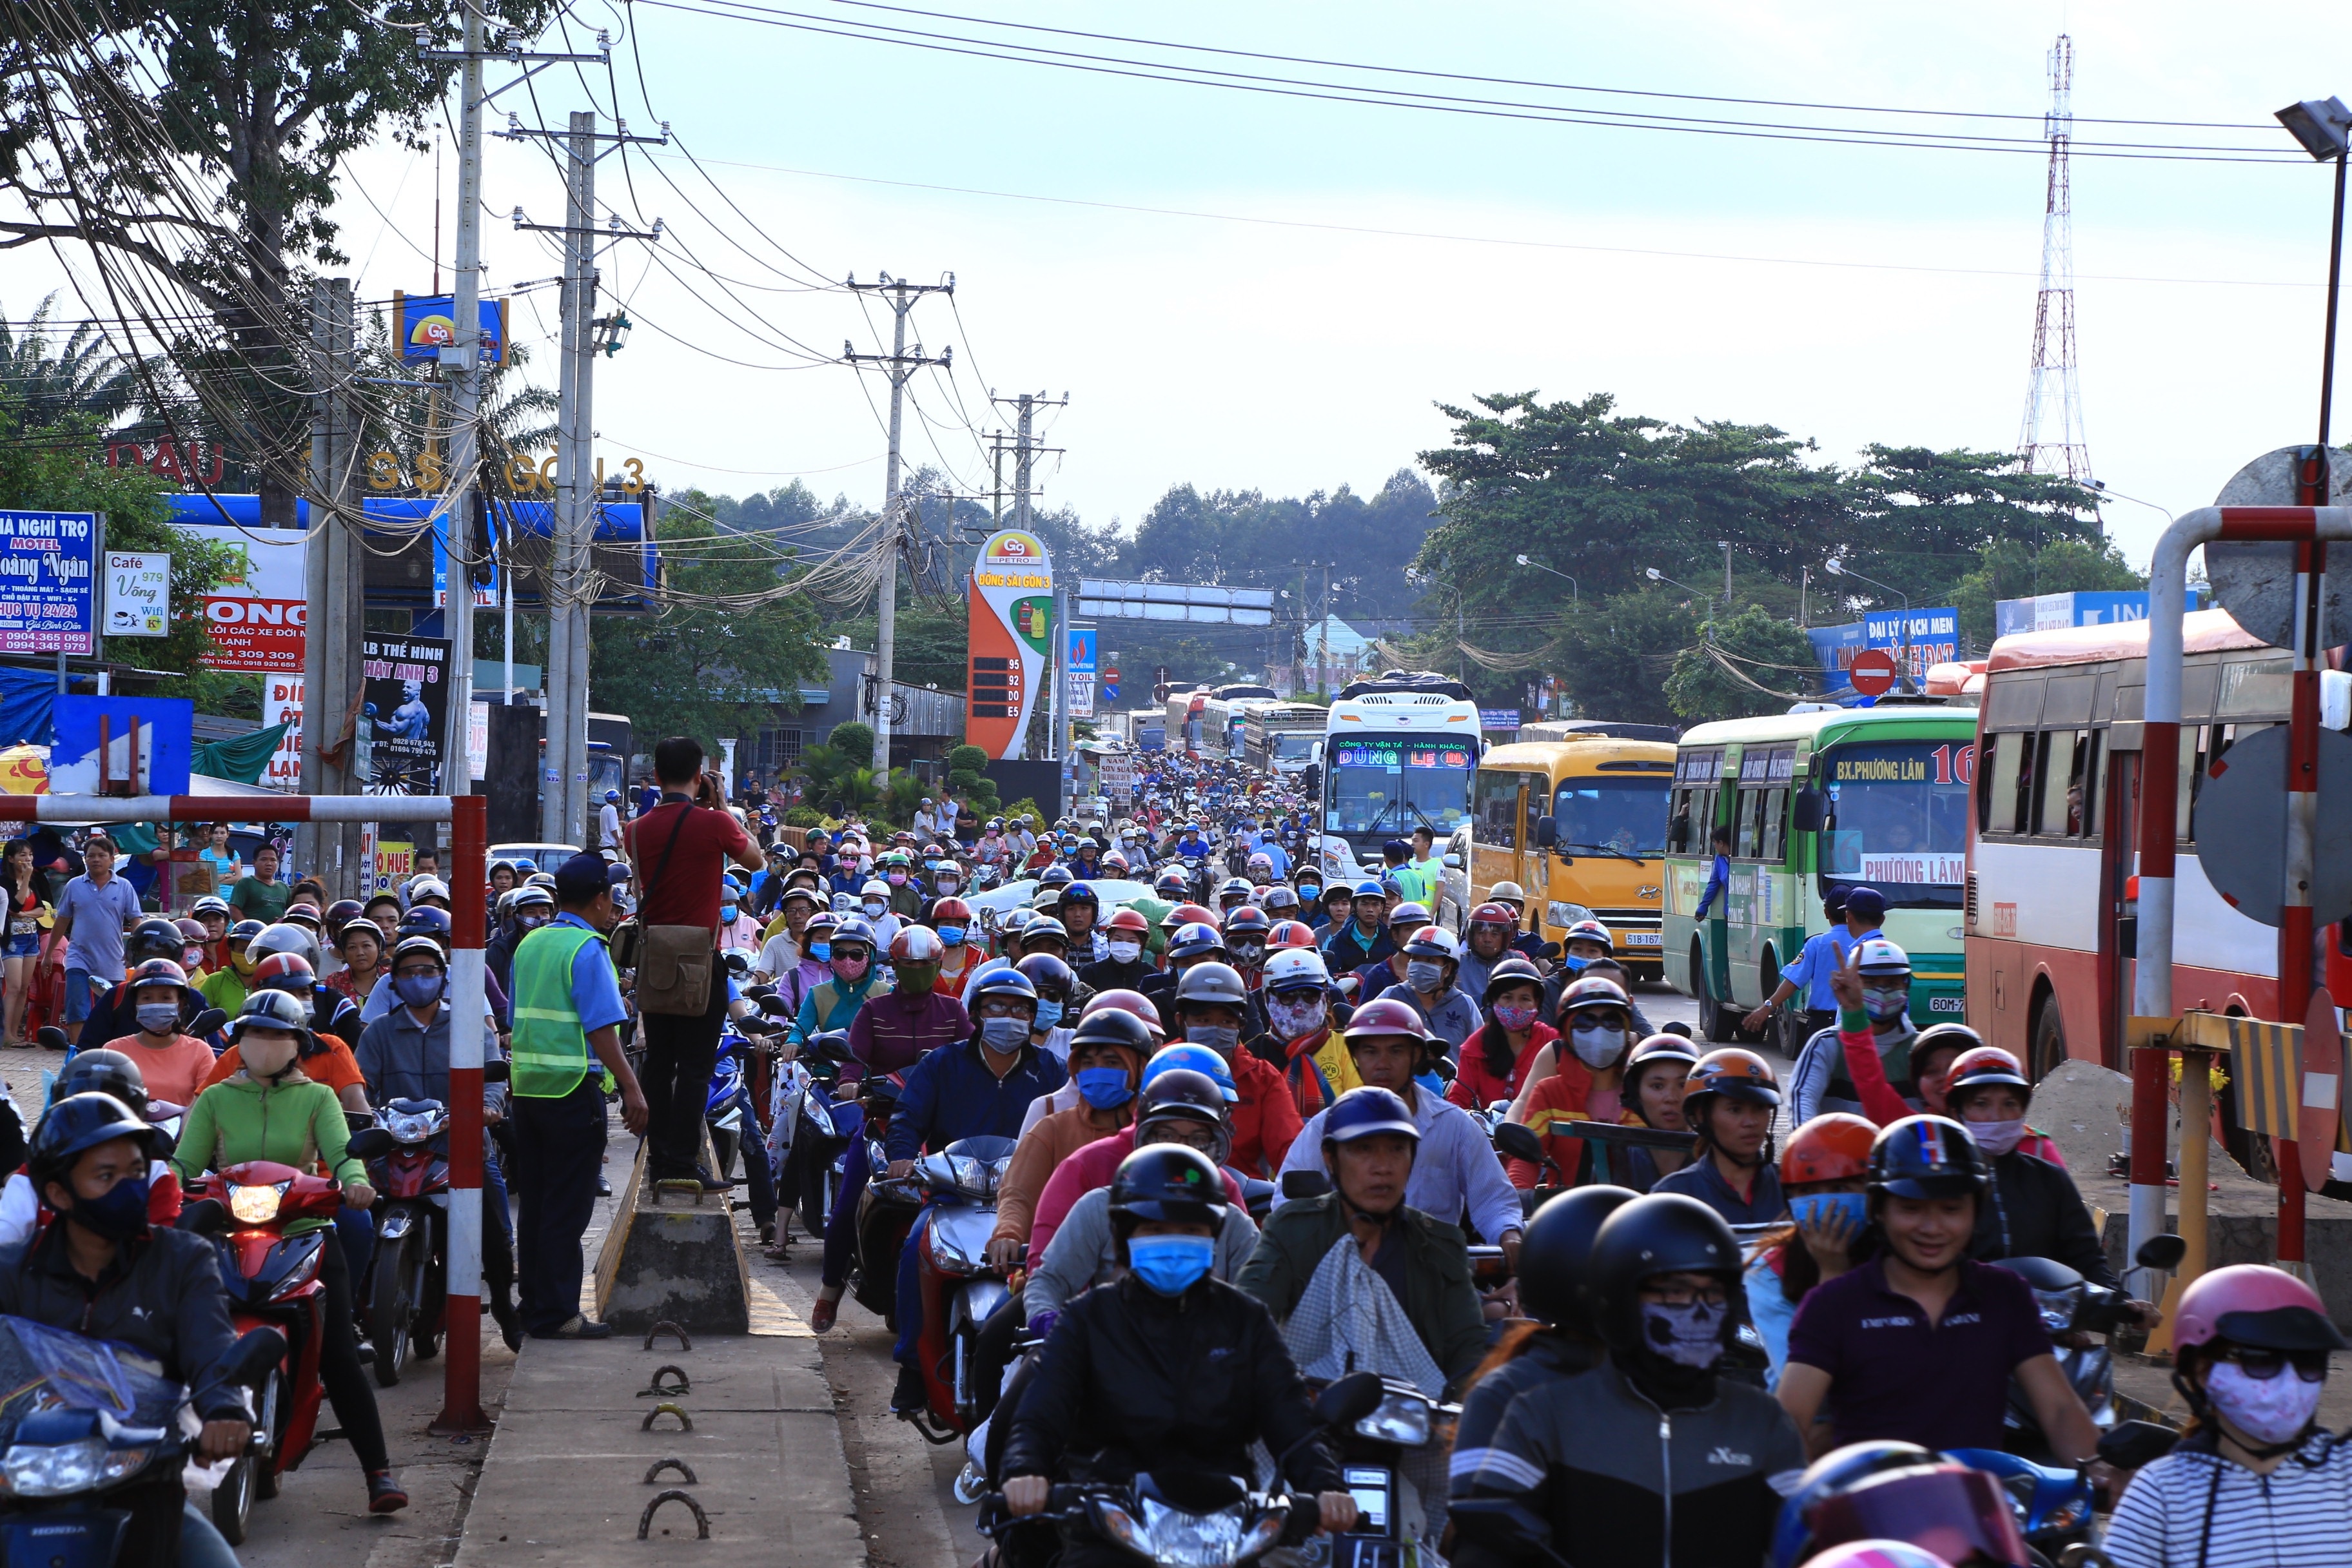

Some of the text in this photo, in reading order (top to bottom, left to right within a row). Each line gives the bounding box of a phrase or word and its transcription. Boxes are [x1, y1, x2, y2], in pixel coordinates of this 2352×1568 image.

[622, 458, 643, 495] 3
[19, 515, 55, 536] NGHỈ
[60, 520, 88, 542] TRỌ
[10, 537, 61, 551] MOTEL
[0, 551, 88, 585] oàng Ngân
[112, 557, 143, 568] Café
[142, 572, 163, 582] 979
[979, 570, 1050, 588] ĐÔNG SÀI GÒN 3
[116, 574, 157, 603] Võng
[23, 603, 41, 620] VỤ
[43, 603, 77, 618] 24/24
[141, 606, 163, 616] Wifi
[26, 620, 41, 632] Giá
[62, 621, 82, 631] Dân
[230, 626, 255, 635] CÁC
[275, 627, 297, 637] ĐỜI
[1868, 621, 1886, 642] ĐẠI
[1888, 616, 1900, 638] LÝ
[1931, 617, 1954, 635] MEN
[6, 632, 61, 642] 0904.365
[219, 638, 251, 647] LẠNH
[6, 641, 61, 650] 0994.345
[382, 641, 407, 658] THỂ
[411, 645, 444, 661] HÌNH
[364, 658, 438, 683] HẬT ANH 3
[1009, 659, 1019, 670] 95
[1008, 675, 1019, 686] 92
[1008, 706, 1019, 717] E5
[1375, 741, 1391, 749] VẬN
[1439, 741, 1465, 750] KHÁCH
[1838, 744, 1974, 784] BX.PHƯƠNG LÂM 16
[387, 848, 410, 873] HUẾ
[1865, 856, 1964, 883] PHƯƠNG LÂM
[1628, 936, 1662, 944] 51B-167.
[32, 1525, 86, 1536] HONDA
